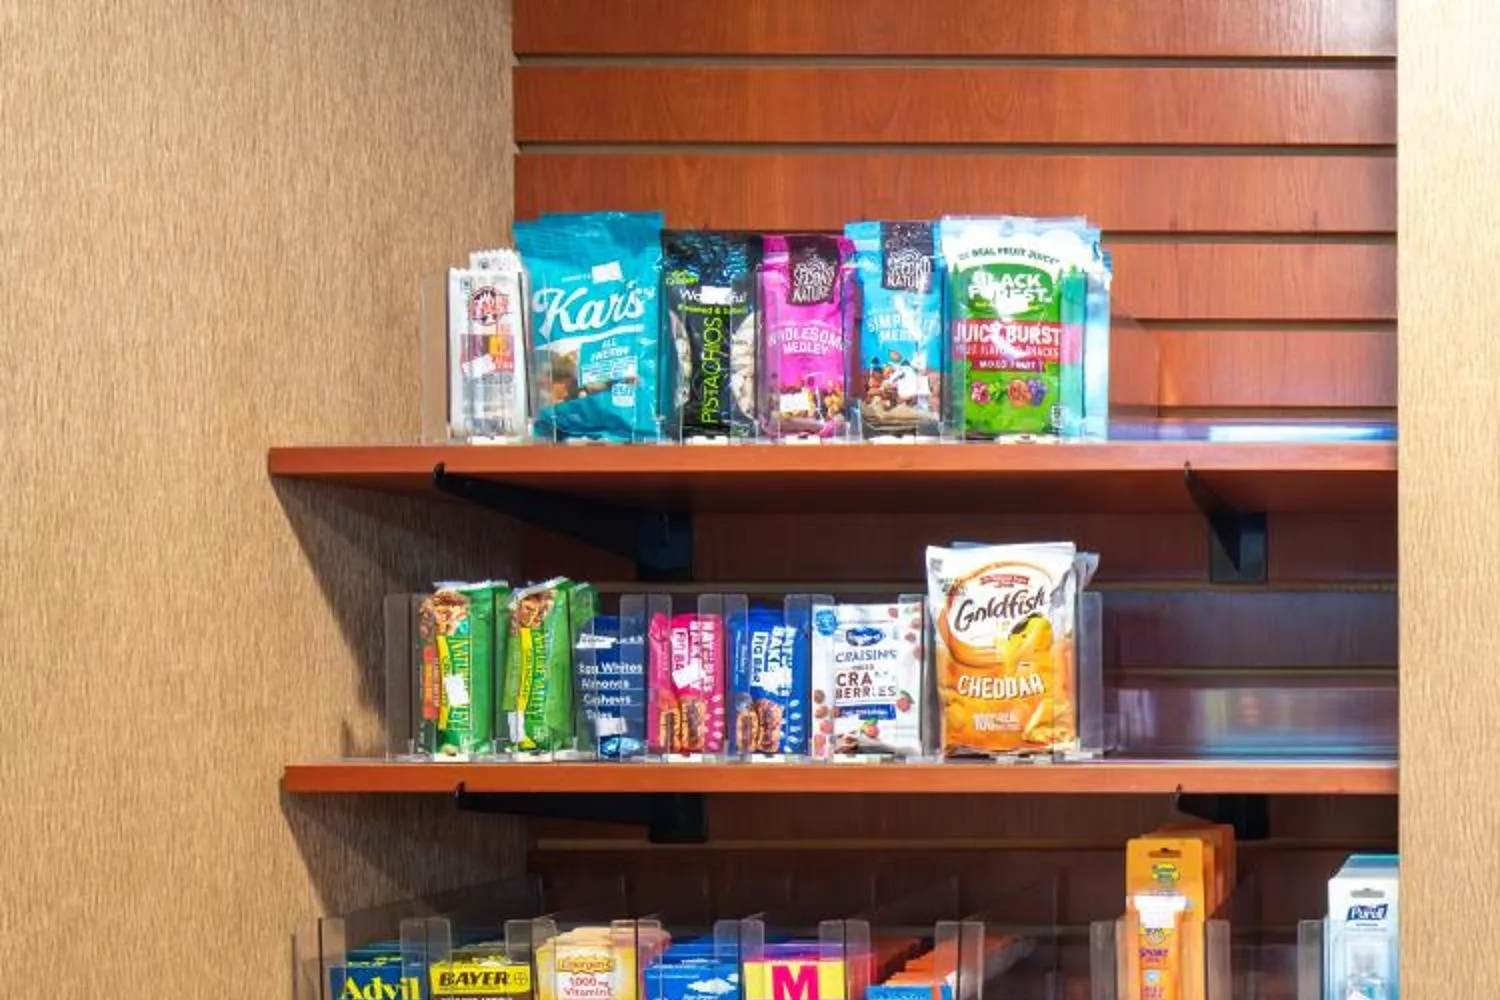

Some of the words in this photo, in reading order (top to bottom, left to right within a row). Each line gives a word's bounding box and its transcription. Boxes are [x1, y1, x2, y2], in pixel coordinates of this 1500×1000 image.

[1007, 325, 1062, 346] BURST
[700, 316, 726, 424] PISTACHIOS
[953, 584, 1046, 633] Goldfish
[600, 661, 644, 674] Whites
[956, 672, 1046, 700] CHEDDAR
[438, 970, 509, 987] BAYER
